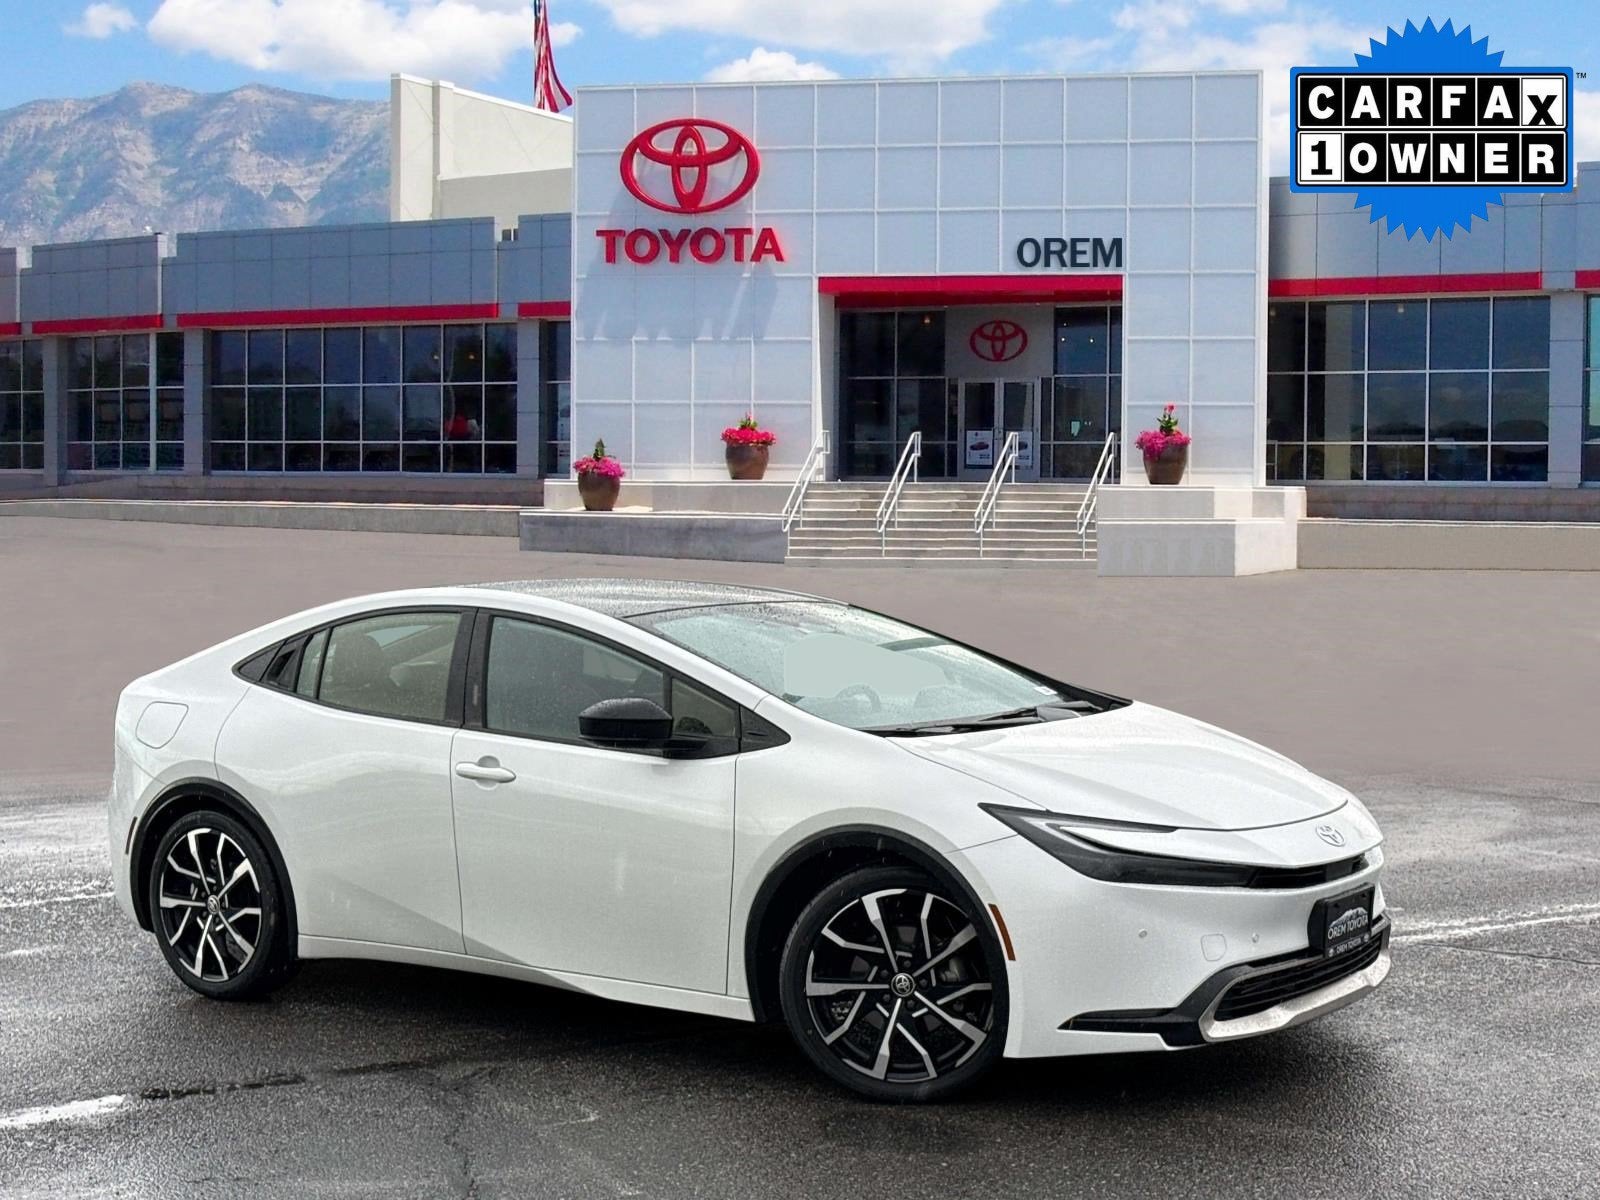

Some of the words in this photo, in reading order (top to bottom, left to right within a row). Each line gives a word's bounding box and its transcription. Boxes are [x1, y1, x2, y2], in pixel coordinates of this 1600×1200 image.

[596, 227, 785, 264] TOYOTA
[1017, 237, 1123, 268] OREM
[1328, 924, 1347, 940] OREM
[1347, 914, 1369, 931] TOYOTA
